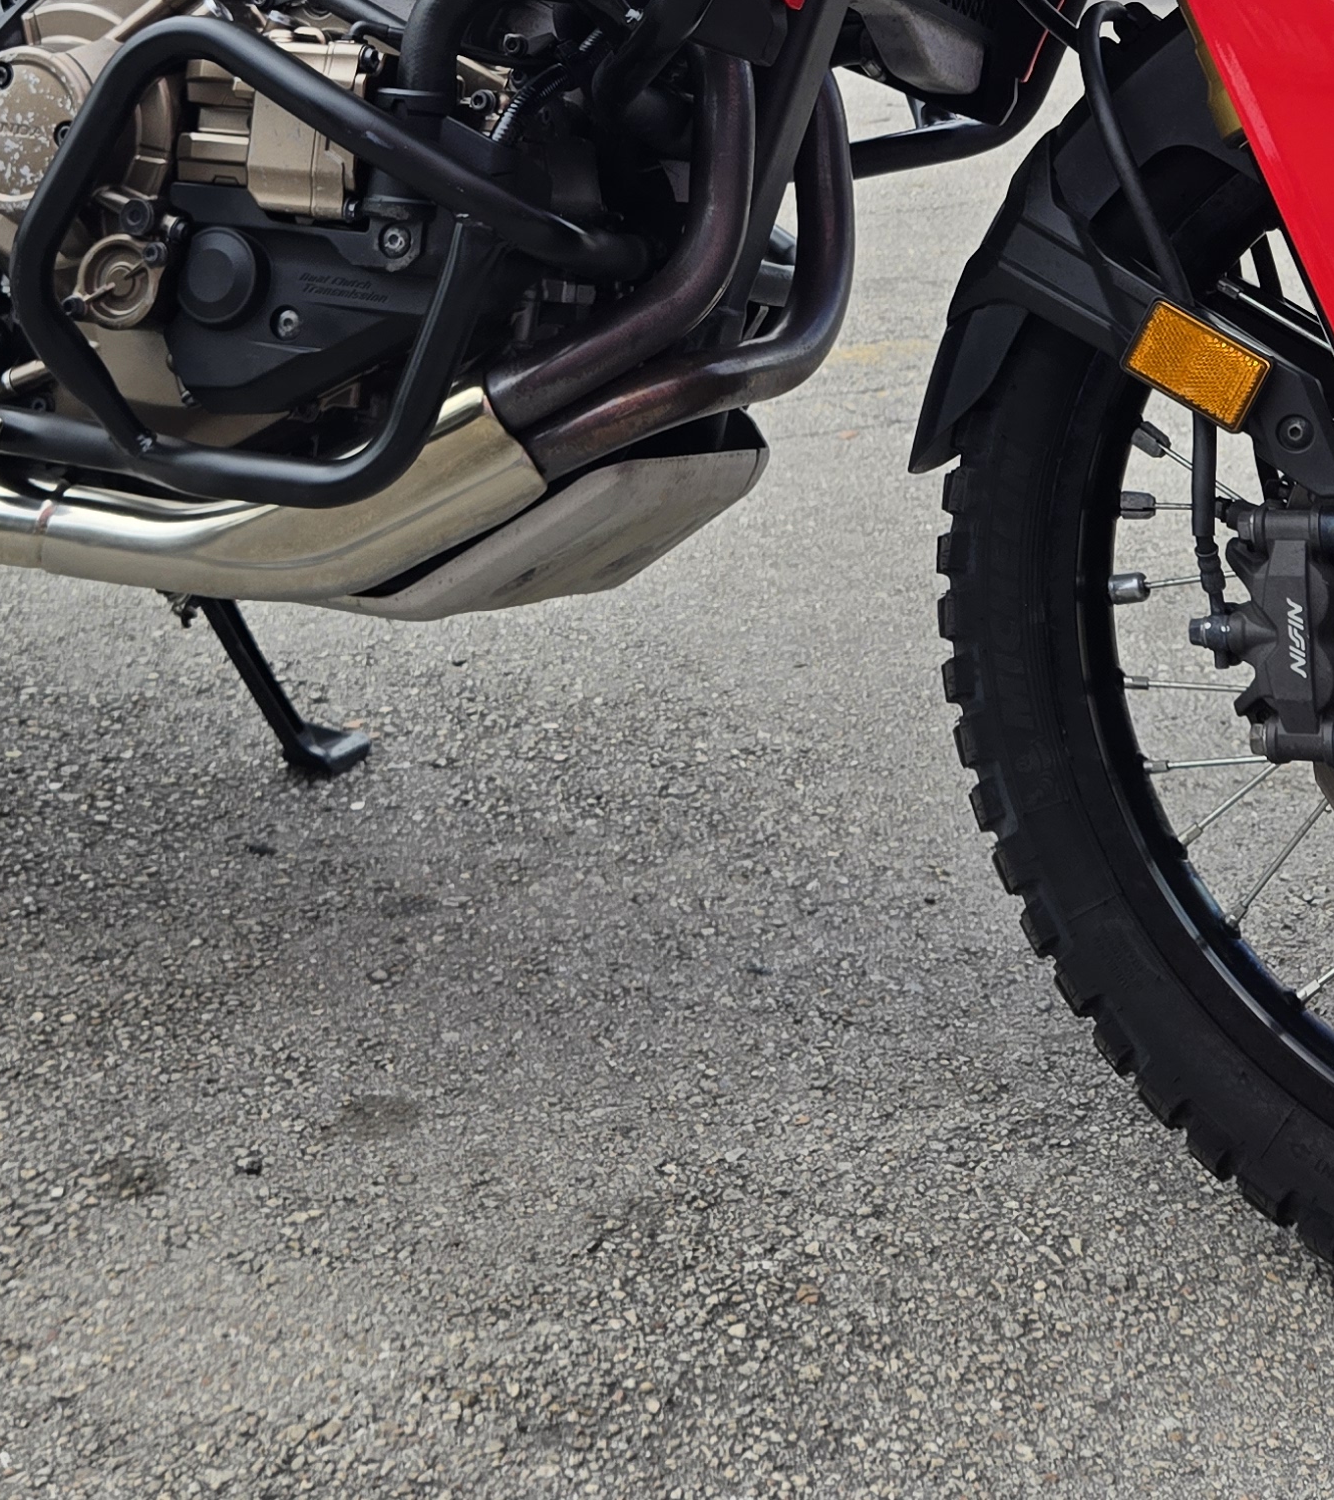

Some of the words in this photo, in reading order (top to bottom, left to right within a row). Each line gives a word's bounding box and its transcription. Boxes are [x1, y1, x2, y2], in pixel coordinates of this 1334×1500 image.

[299, 272, 330, 284] Dual
[331, 276, 372, 291] Clutch
[302, 284, 388, 304] Transmission
